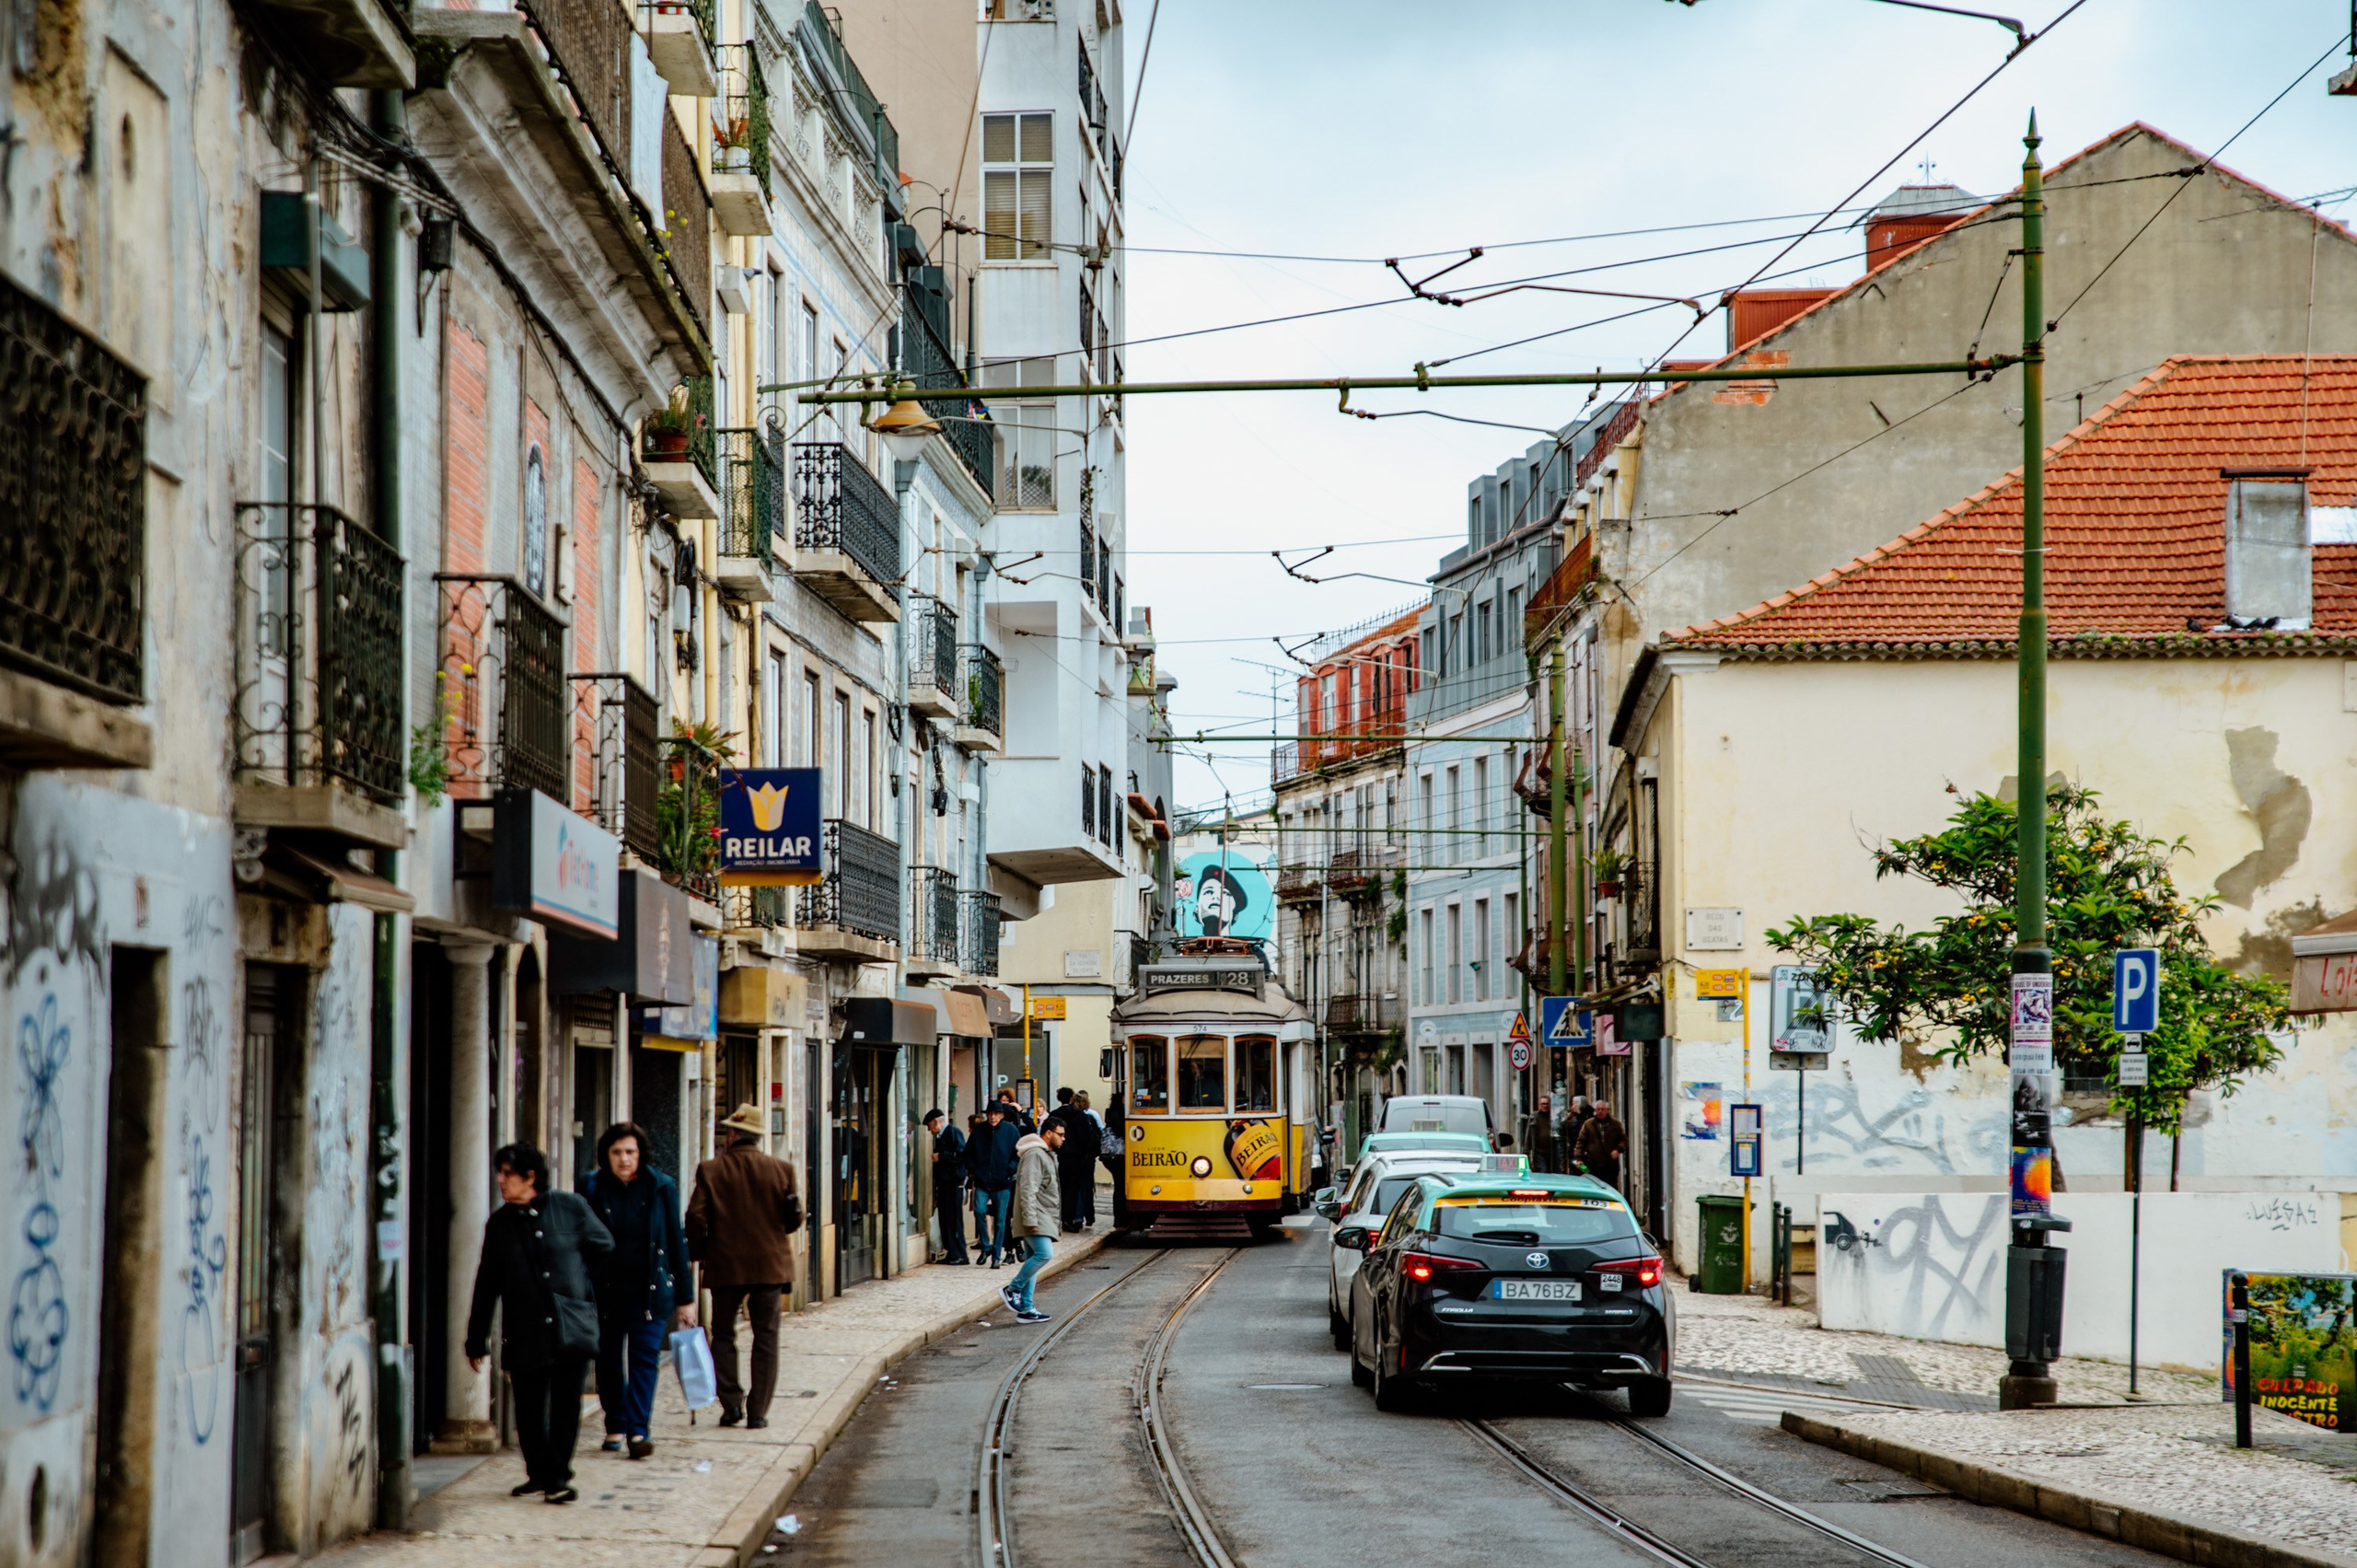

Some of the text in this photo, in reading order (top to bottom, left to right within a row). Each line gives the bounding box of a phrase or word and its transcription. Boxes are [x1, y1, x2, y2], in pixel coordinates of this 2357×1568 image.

[726, 836, 811, 858] REILAR
[735, 858, 764, 866] MEDIAÇÃO
[1151, 971, 1249, 985] PRAZERES 28
[2121, 957, 2147, 1025] P
[1514, 1050, 1527, 1061] 30
[1236, 1132, 1278, 1167] BEIRÃO
[1132, 1150, 1187, 1167] BEIRÃO
[1497, 1156, 1517, 1169] TAXI
[1584, 1199, 1608, 1208] 103
[1602, 1274, 1621, 1283] 2448
[2258, 1377, 2338, 1395] CULPADO
[2259, 1395, 2339, 1411] INOCENTE
